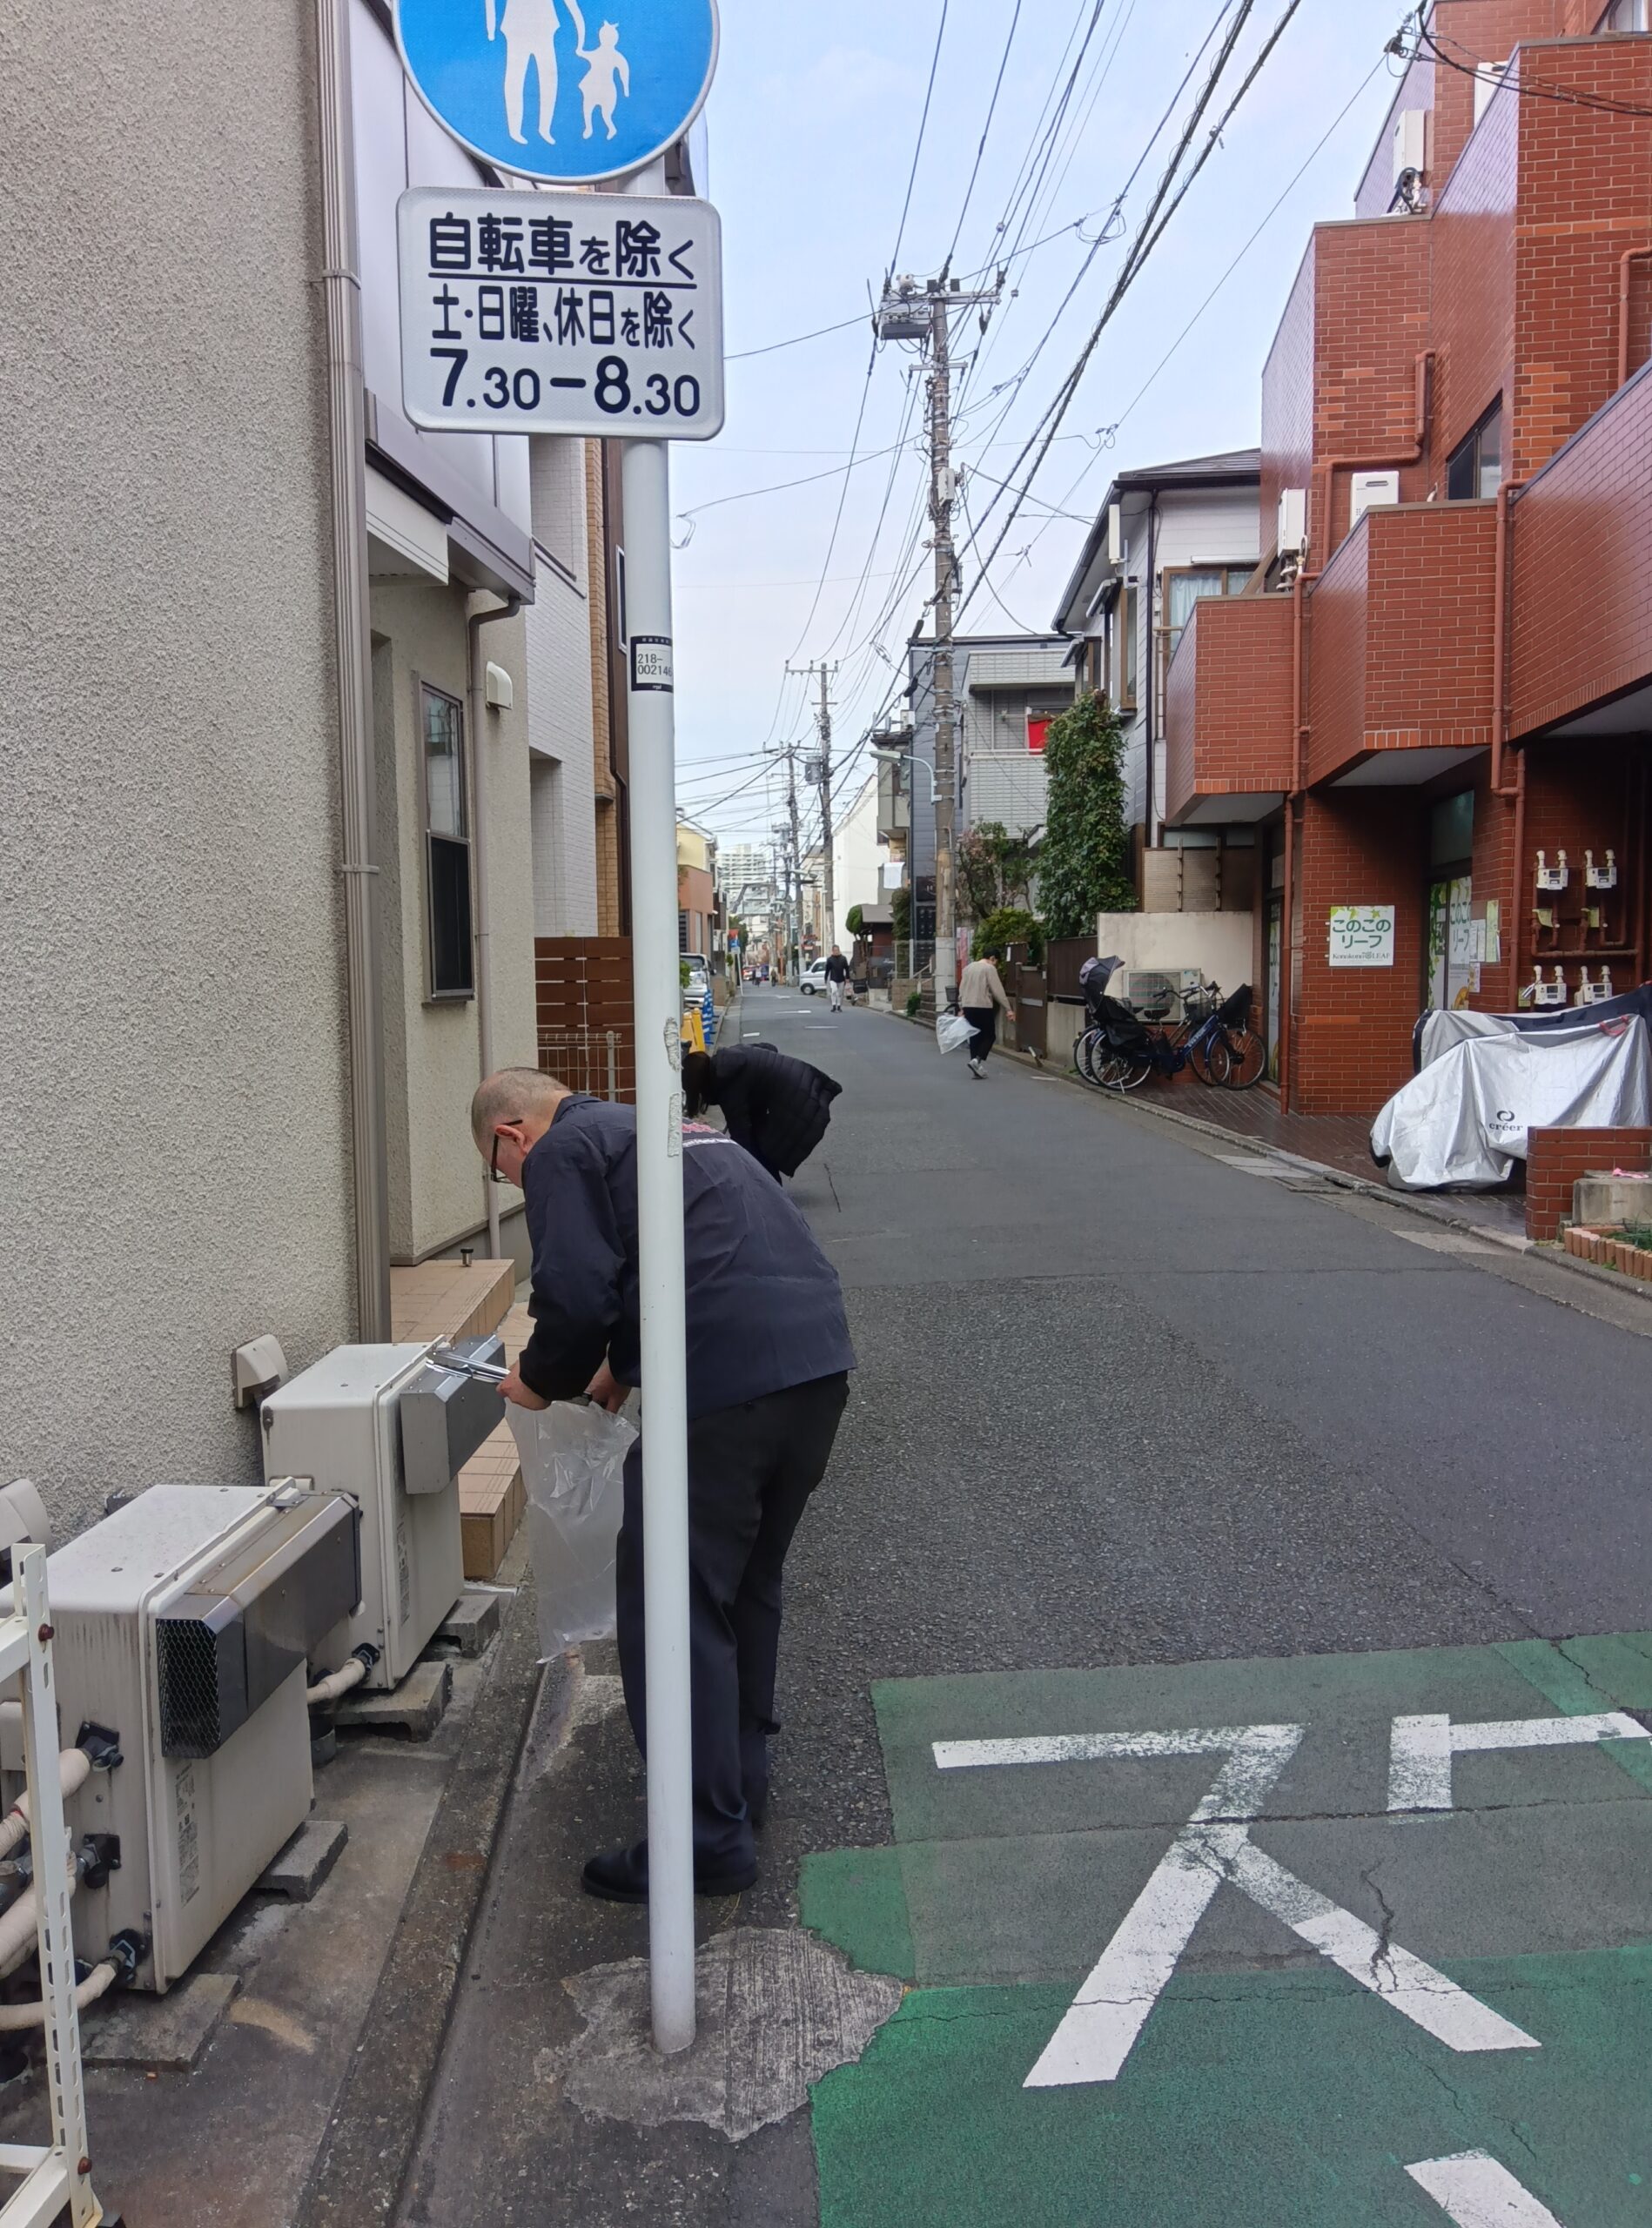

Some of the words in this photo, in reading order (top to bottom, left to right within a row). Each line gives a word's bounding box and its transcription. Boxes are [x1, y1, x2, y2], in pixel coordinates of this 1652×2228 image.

[429, 211, 694, 280] 自転車を除く
[638, 654, 663, 663] 218-
[1450, 902, 1471, 924] このこ
[1333, 919, 1391, 932] このこの
[1341, 935, 1382, 949] リーフ
[1488, 1122, 1523, 1131] créer
